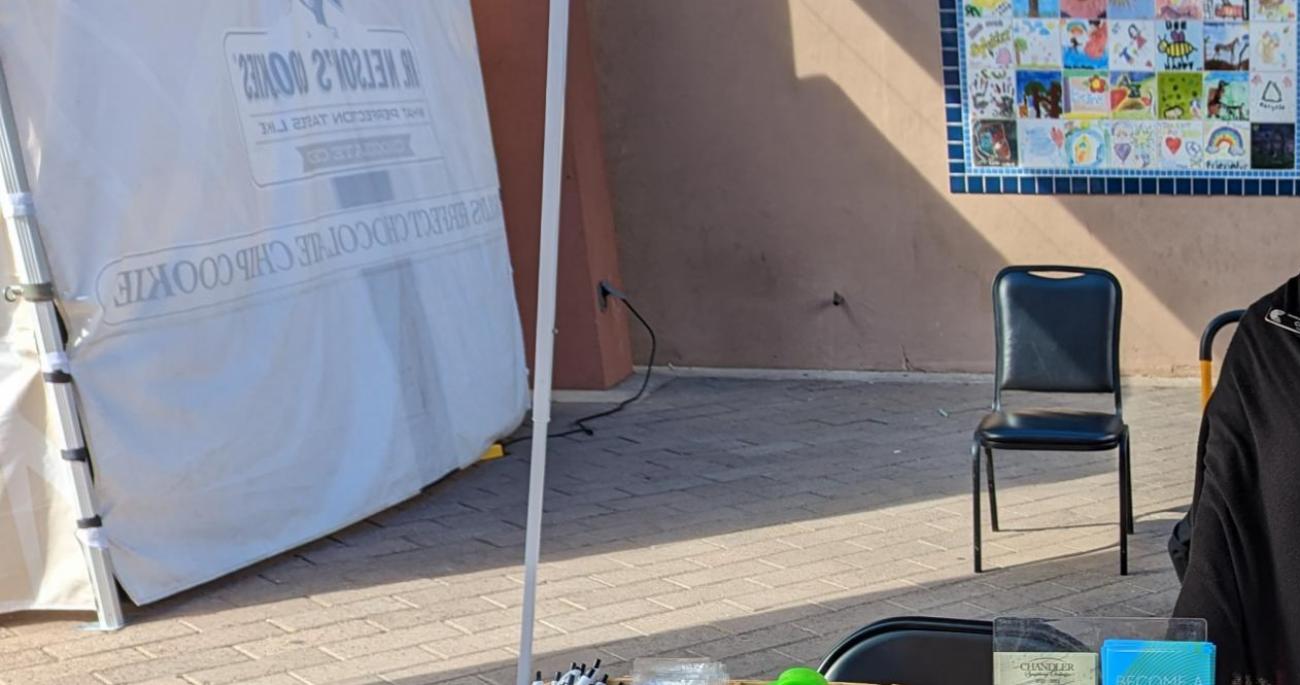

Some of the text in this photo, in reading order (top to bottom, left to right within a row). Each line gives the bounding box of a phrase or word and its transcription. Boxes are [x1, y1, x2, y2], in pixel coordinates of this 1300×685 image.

[1020, 662, 1074, 672] CHANDLER
[1116, 675, 1203, 685] BECOME A
